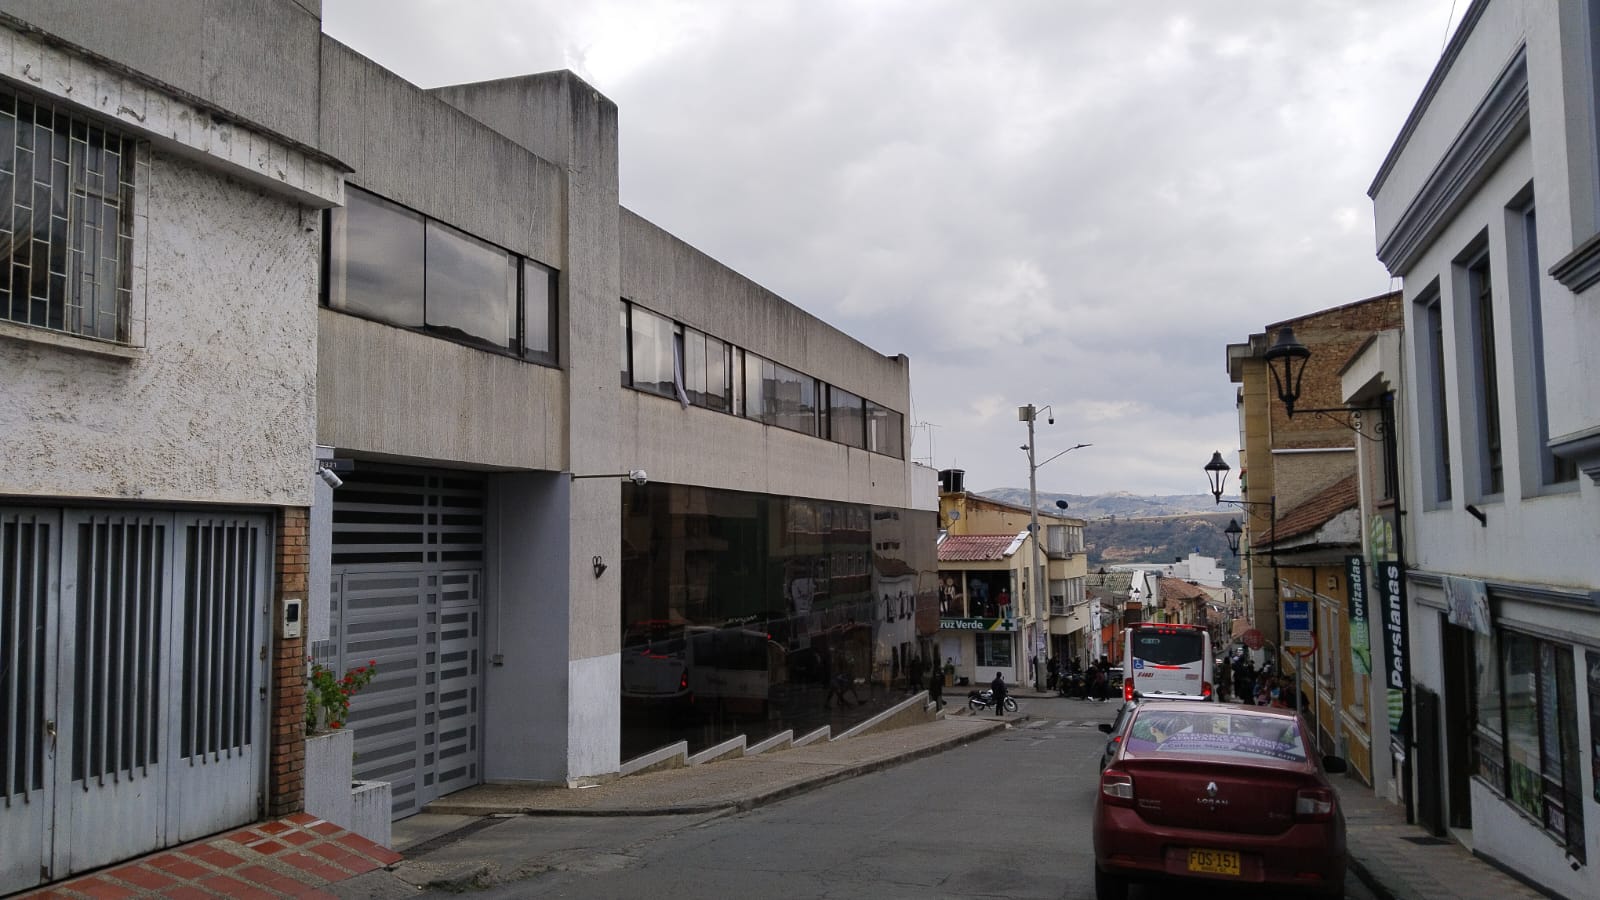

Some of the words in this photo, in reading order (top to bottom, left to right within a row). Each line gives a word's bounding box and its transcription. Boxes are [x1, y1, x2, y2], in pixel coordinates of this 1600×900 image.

[940, 621, 955, 629] ruz
[956, 619, 983, 629] Verde
[1351, 558, 1366, 647] motorizadas
[1388, 566, 1404, 688] Persianas
